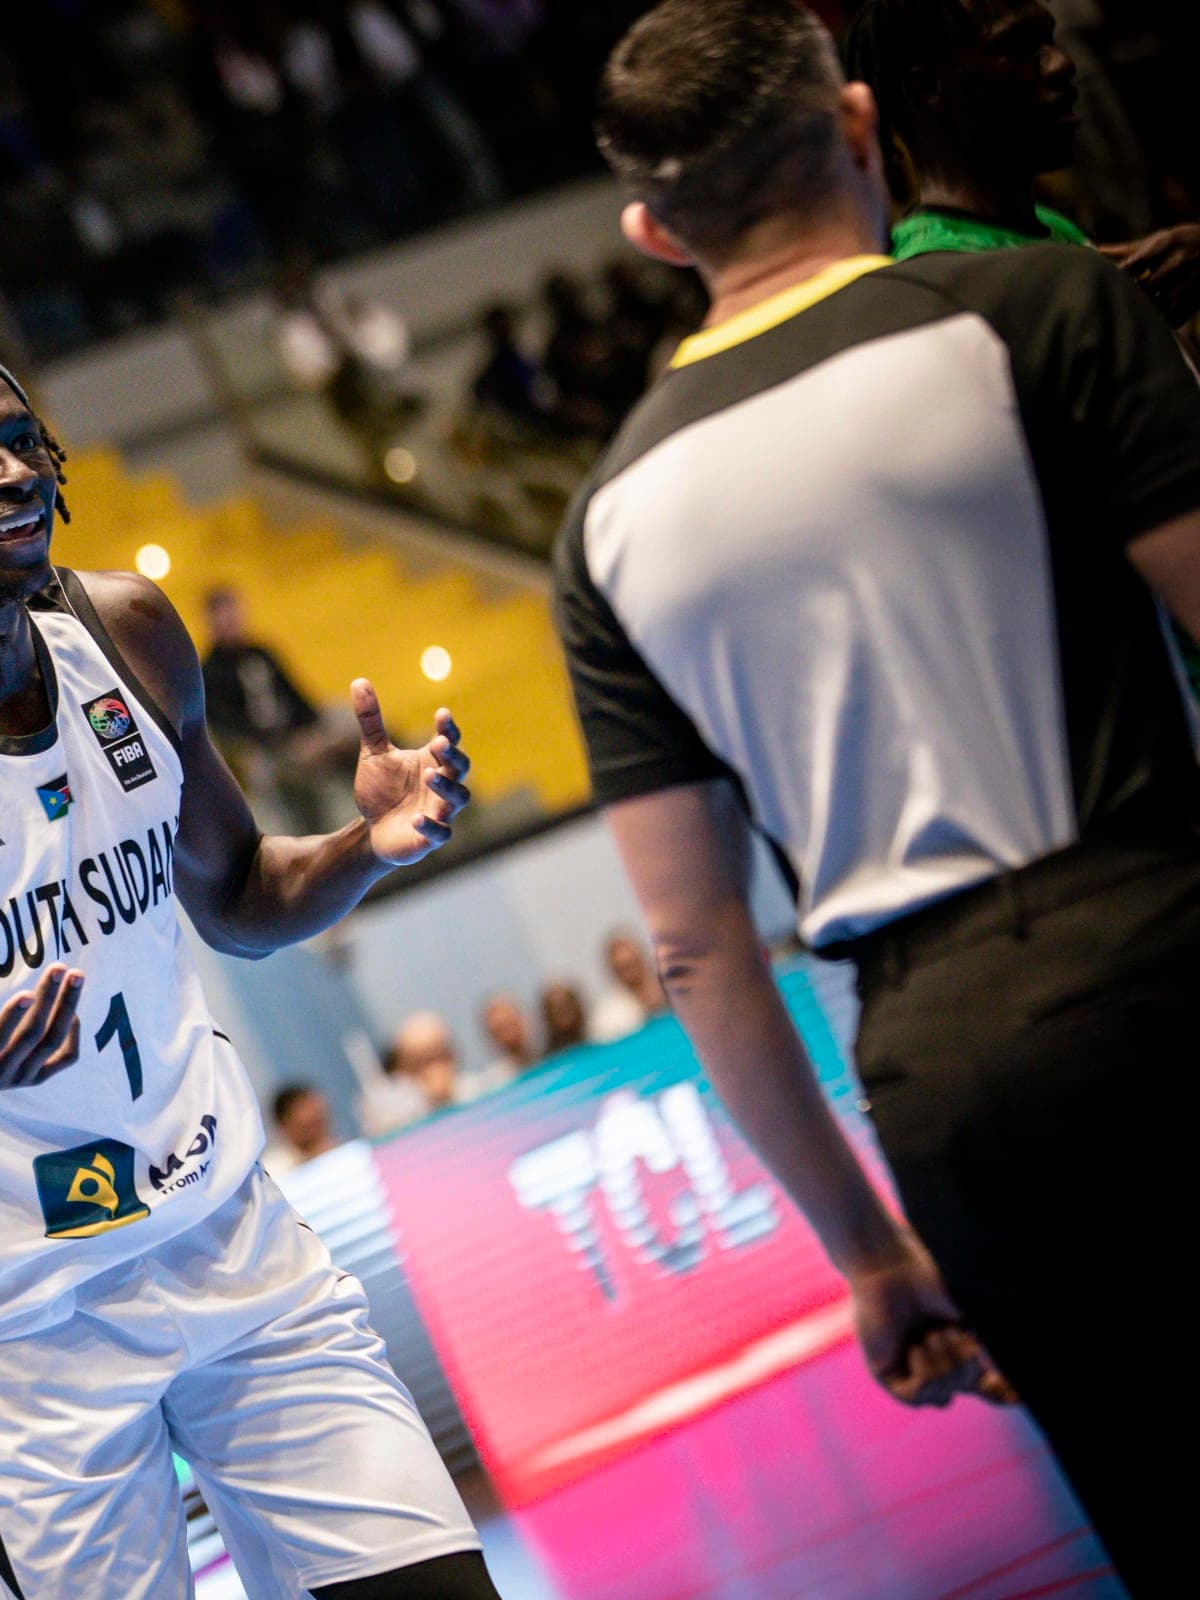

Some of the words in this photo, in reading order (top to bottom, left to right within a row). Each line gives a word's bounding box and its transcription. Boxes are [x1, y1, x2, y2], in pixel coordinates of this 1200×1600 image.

[112, 741, 144, 767] FIBA
[94, 991, 144, 1102] 1
[508, 1082, 781, 1303] TCL
